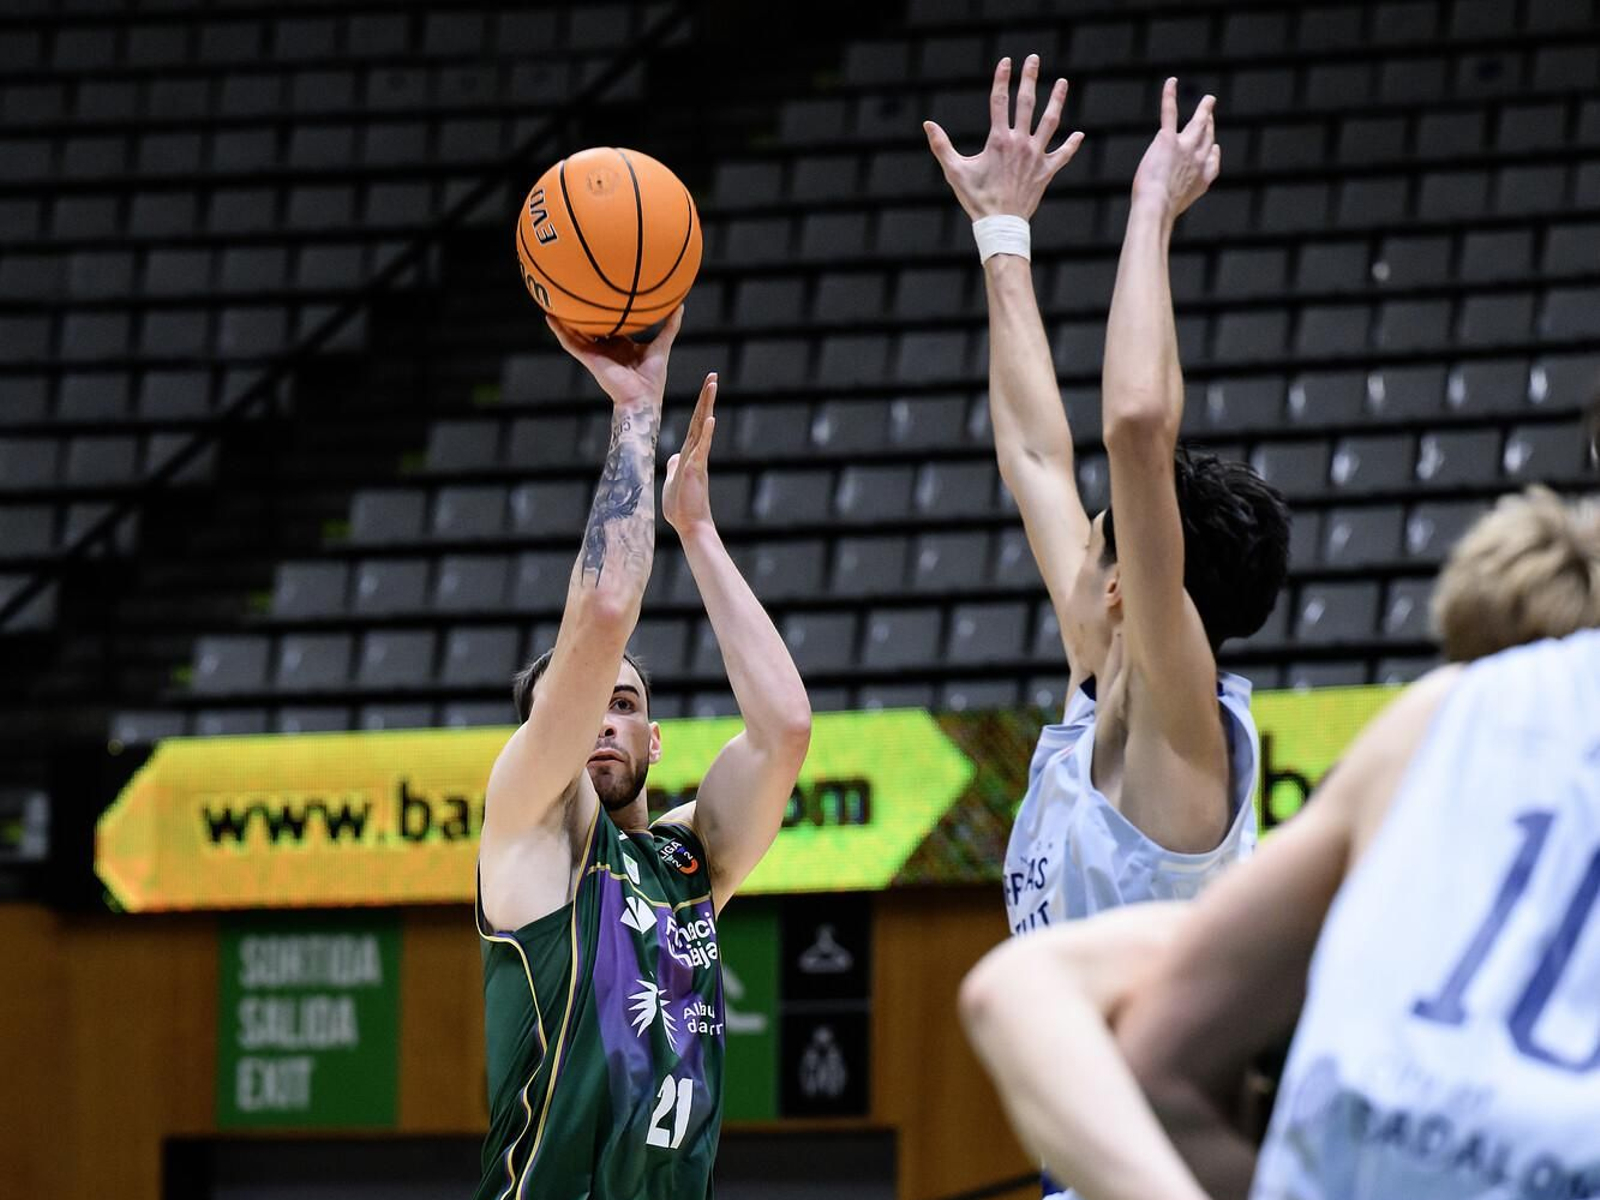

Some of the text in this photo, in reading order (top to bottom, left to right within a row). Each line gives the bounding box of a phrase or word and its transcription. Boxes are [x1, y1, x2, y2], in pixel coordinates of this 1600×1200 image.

[204, 781, 487, 843] www.ba
[240, 934, 382, 988] SORTIDA
[239, 996, 359, 1050] SALIDA
[236, 1055, 314, 1112] EXIT
[646, 1074, 693, 1150] 21
